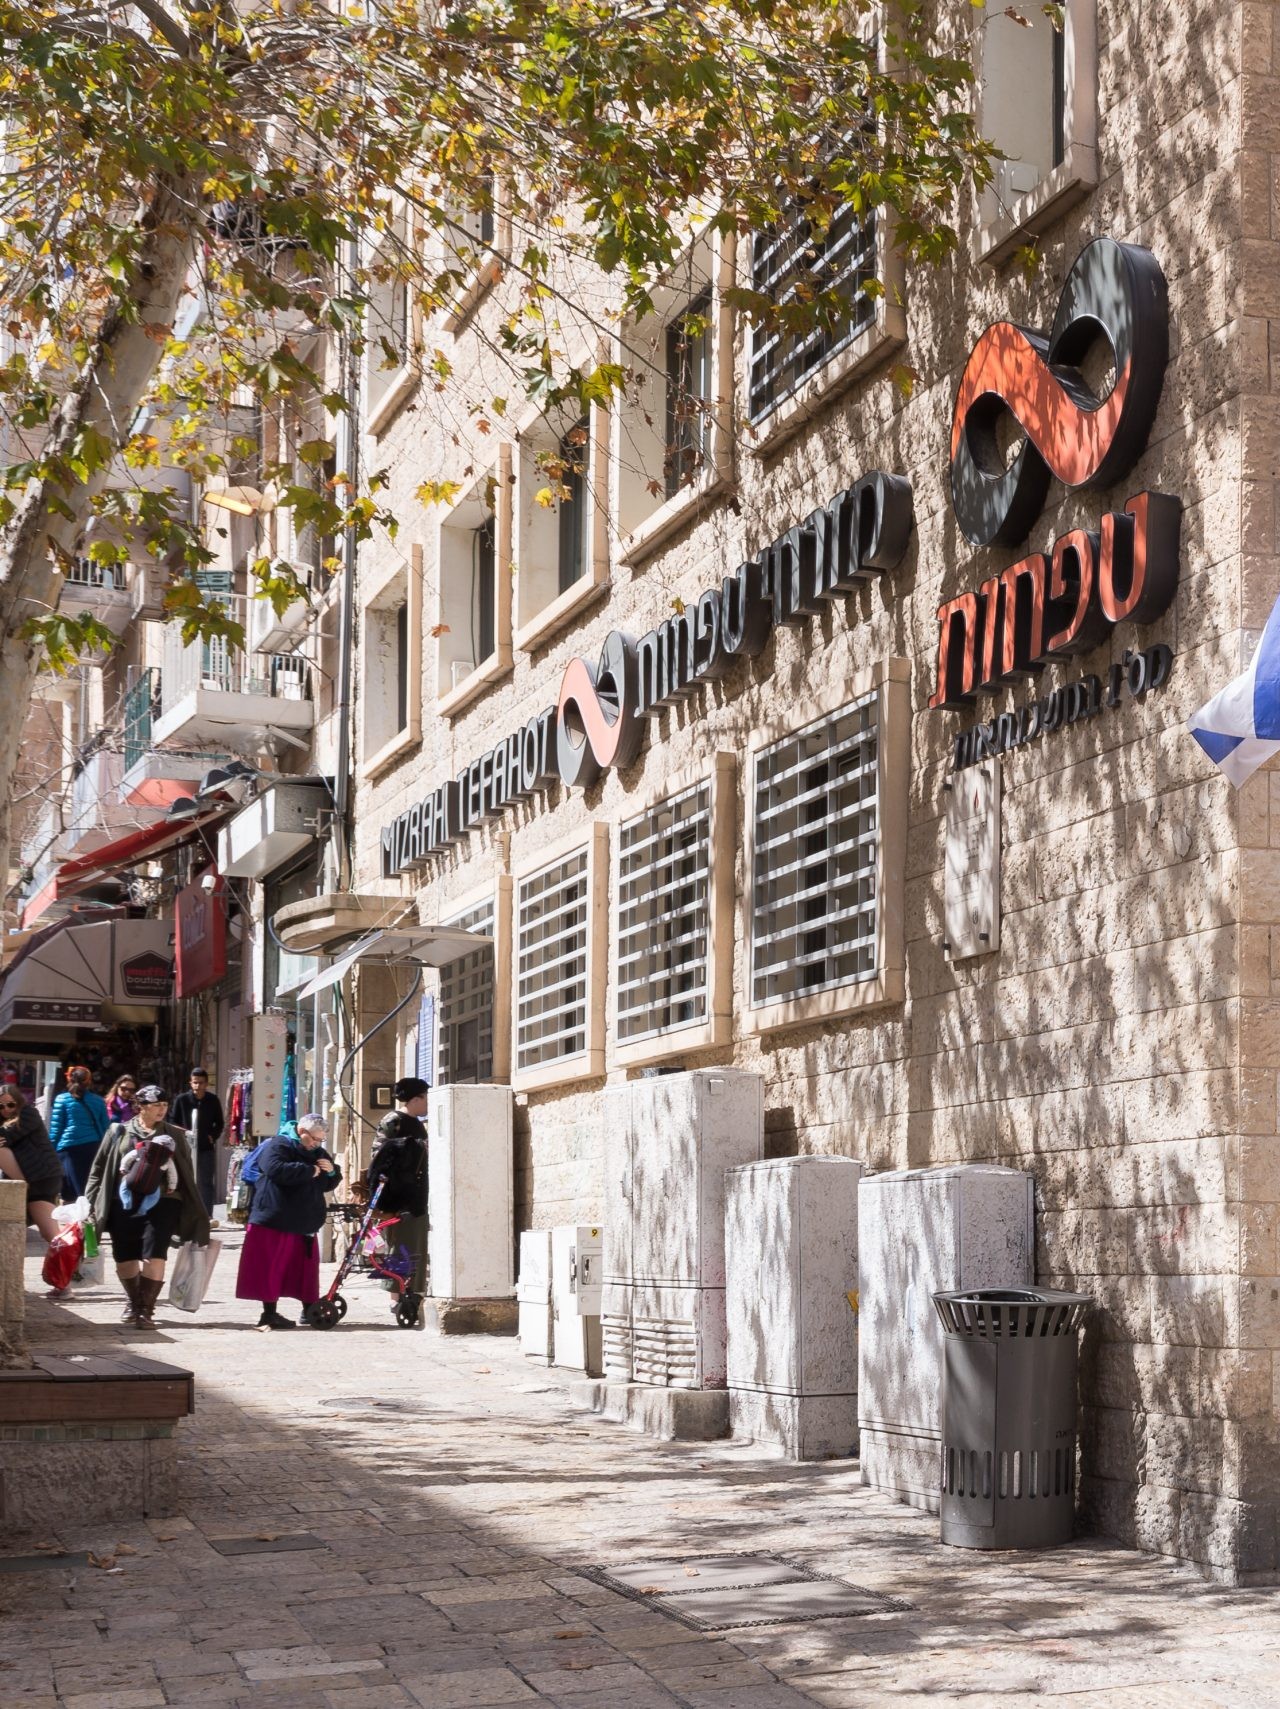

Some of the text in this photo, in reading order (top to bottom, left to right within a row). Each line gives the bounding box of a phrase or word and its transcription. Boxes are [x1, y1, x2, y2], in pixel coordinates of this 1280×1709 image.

[634, 470, 892, 718] מזרחי טפחות
[929, 489, 1152, 710] טפחות
[380, 704, 556, 880] MIZRAHI TEFAHOT
